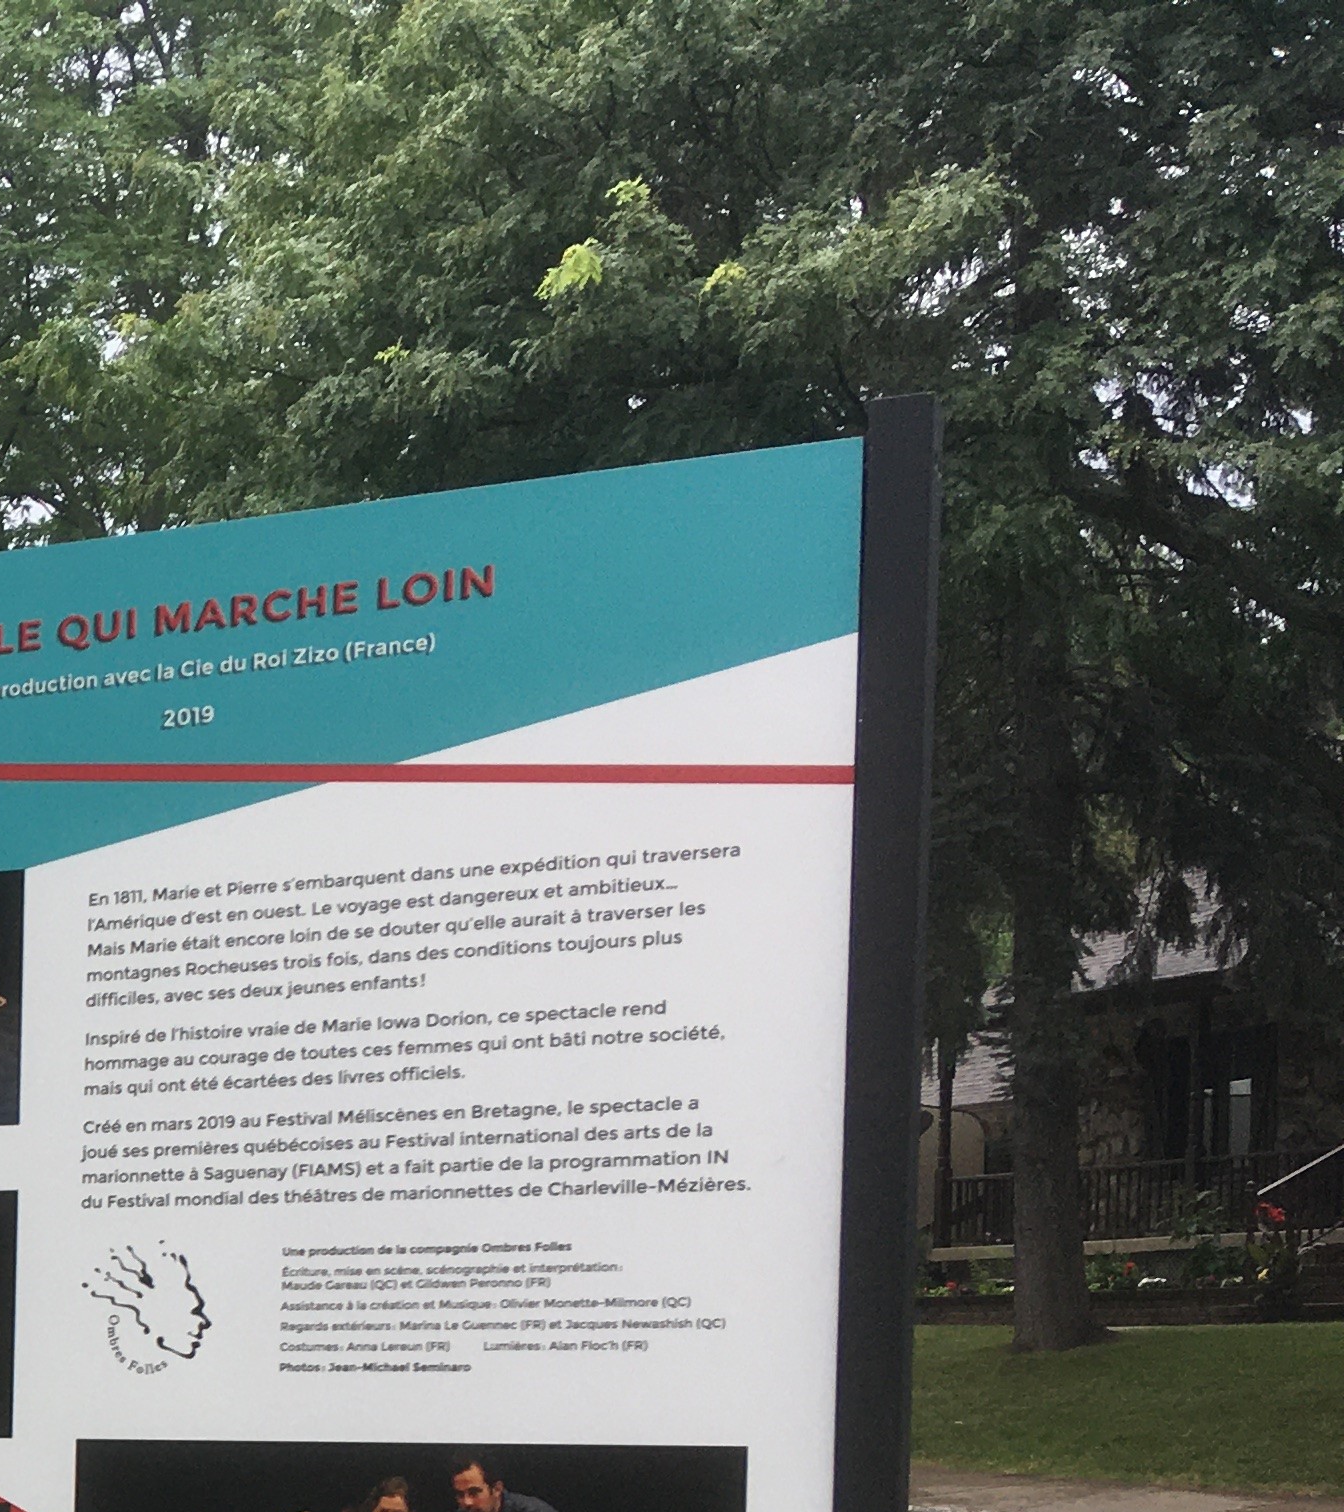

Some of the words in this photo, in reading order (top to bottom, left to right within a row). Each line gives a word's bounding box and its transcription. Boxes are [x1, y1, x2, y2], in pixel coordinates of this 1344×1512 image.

[56, 609, 135, 650] QUI
[154, 583, 358, 637] MARCHE
[376, 565, 492, 610] LOIN
[101, 668, 151, 688] avec
[154, 663, 175, 682] la
[177, 658, 214, 679] Cie
[217, 655, 247, 676] du
[250, 648, 287, 672] Roi
[291, 645, 339, 667] Zizo
[342, 632, 435, 664] (France)
[161, 705, 214, 730] 2019
[88, 892, 109, 907] En
[113, 889, 147, 905] 1811,
[152, 885, 200, 902] Marie
[204, 883, 222, 898] et
[226, 880, 278, 896] Pierre
[282, 869, 406, 892] s'embarquent
[410, 866, 455, 882] dans
[459, 864, 495, 878] une
[499, 854, 601, 876] expédition
[606, 849, 636, 870] qui
[642, 845, 741, 864] traversera
[87, 913, 177, 932] l'Amérique
[180, 909, 222, 925] d'est
[226, 909, 248, 922] en
[252, 903, 306, 920] ouest.
[311, 902, 332, 916] Le
[336, 898, 402, 916] voyage
[406, 893, 435, 909] est
[439, 887, 539, 908] dangereux
[543, 884, 563, 899] et
[87, 941, 126, 957] Mais
[129, 937, 178, 954] Marie
[181, 934, 221, 951] était
[224, 933, 285, 948] encore
[289, 927, 322, 943] loin
[326, 925, 350, 941] de
[354, 926, 375, 939] se
[378, 920, 441, 937] douter
[445, 914, 506, 935] qu'elle
[511, 910, 566, 928] aurait
[570, 909, 582, 924] à
[587, 905, 674, 923] traverser
[679, 901, 706, 916] les
[85, 990, 160, 1008] difficiles,
[163, 990, 203, 1003] avec
[208, 987, 236, 1001] ses
[240, 983, 284, 999] deux
[285, 980, 347, 1000] jeunes
[85, 1029, 141, 1048] Inspiré
[145, 1028, 167, 1043] de
[170, 1024, 243, 1042] l'histoire
[247, 1021, 290, 1038] vraie
[293, 1020, 317, 1035] de
[321, 1016, 372, 1033] Marie
[377, 1016, 420, 1030] Iowa
[426, 1010, 493, 1028] Dorion,
[497, 1011, 520, 1024] ce
[524, 1002, 617, 1025] spectacle
[622, 999, 667, 1017] rend
[84, 1056, 169, 1072] hommage
[173, 1055, 194, 1067] au
[198, 1051, 269, 1067] courage
[273, 1047, 296, 1062] de
[300, 1045, 358, 1060] toutes
[362, 1044, 392, 1057] ces
[397, 1040, 473, 1055] femmes
[477, 1035, 507, 1054] qui
[511, 1034, 544, 1050] ont
[549, 1030, 586, 1048] bâti
[591, 1030, 644, 1046] notre
[648, 1024, 725, 1043] société,
[82, 1119, 122, 1135] Créé
[125, 1121, 147, 1133] en
[151, 1119, 193, 1131] mars
[197, 1114, 236, 1130] 2019
[239, 1117, 261, 1128] au
[266, 1110, 333, 1127] Festival
[337, 1107, 438, 1124] Méliscènes
[442, 1108, 465, 1120] en
[471, 1103, 562, 1121] Bretagne,
[567, 1100, 584, 1115] le
[589, 1096, 683, 1117] spectacle
[688, 1098, 699, 1110] a
[81, 1168, 185, 1184] marionnette
[188, 1167, 199, 1181] à
[203, 1166, 288, 1183] Saguenay
[291, 1160, 361, 1180] (FIAMS)
[365, 1161, 384, 1176] et
[388, 1163, 399, 1175] a
[404, 1159, 435, 1174] fait
[439, 1157, 494, 1176] partie
[498, 1156, 523, 1171] de
[528, 1155, 544, 1170] la
[549, 1150, 701, 1173] programmation
[707, 1149, 729, 1164] IN
[80, 1194, 103, 1209] du
[107, 1192, 170, 1208] Festival
[174, 1190, 244, 1206] mondial
[248, 1190, 279, 1205] des
[283, 1188, 357, 1204] théâtres
[361, 1187, 385, 1202] de
[389, 1184, 514, 1201] marionnettes
[518, 1182, 543, 1197] de
[547, 1176, 751, 1197] Charleville-Mézières.
[107, 1313, 127, 1364] Ombres
[127, 1359, 169, 1375] Folles
